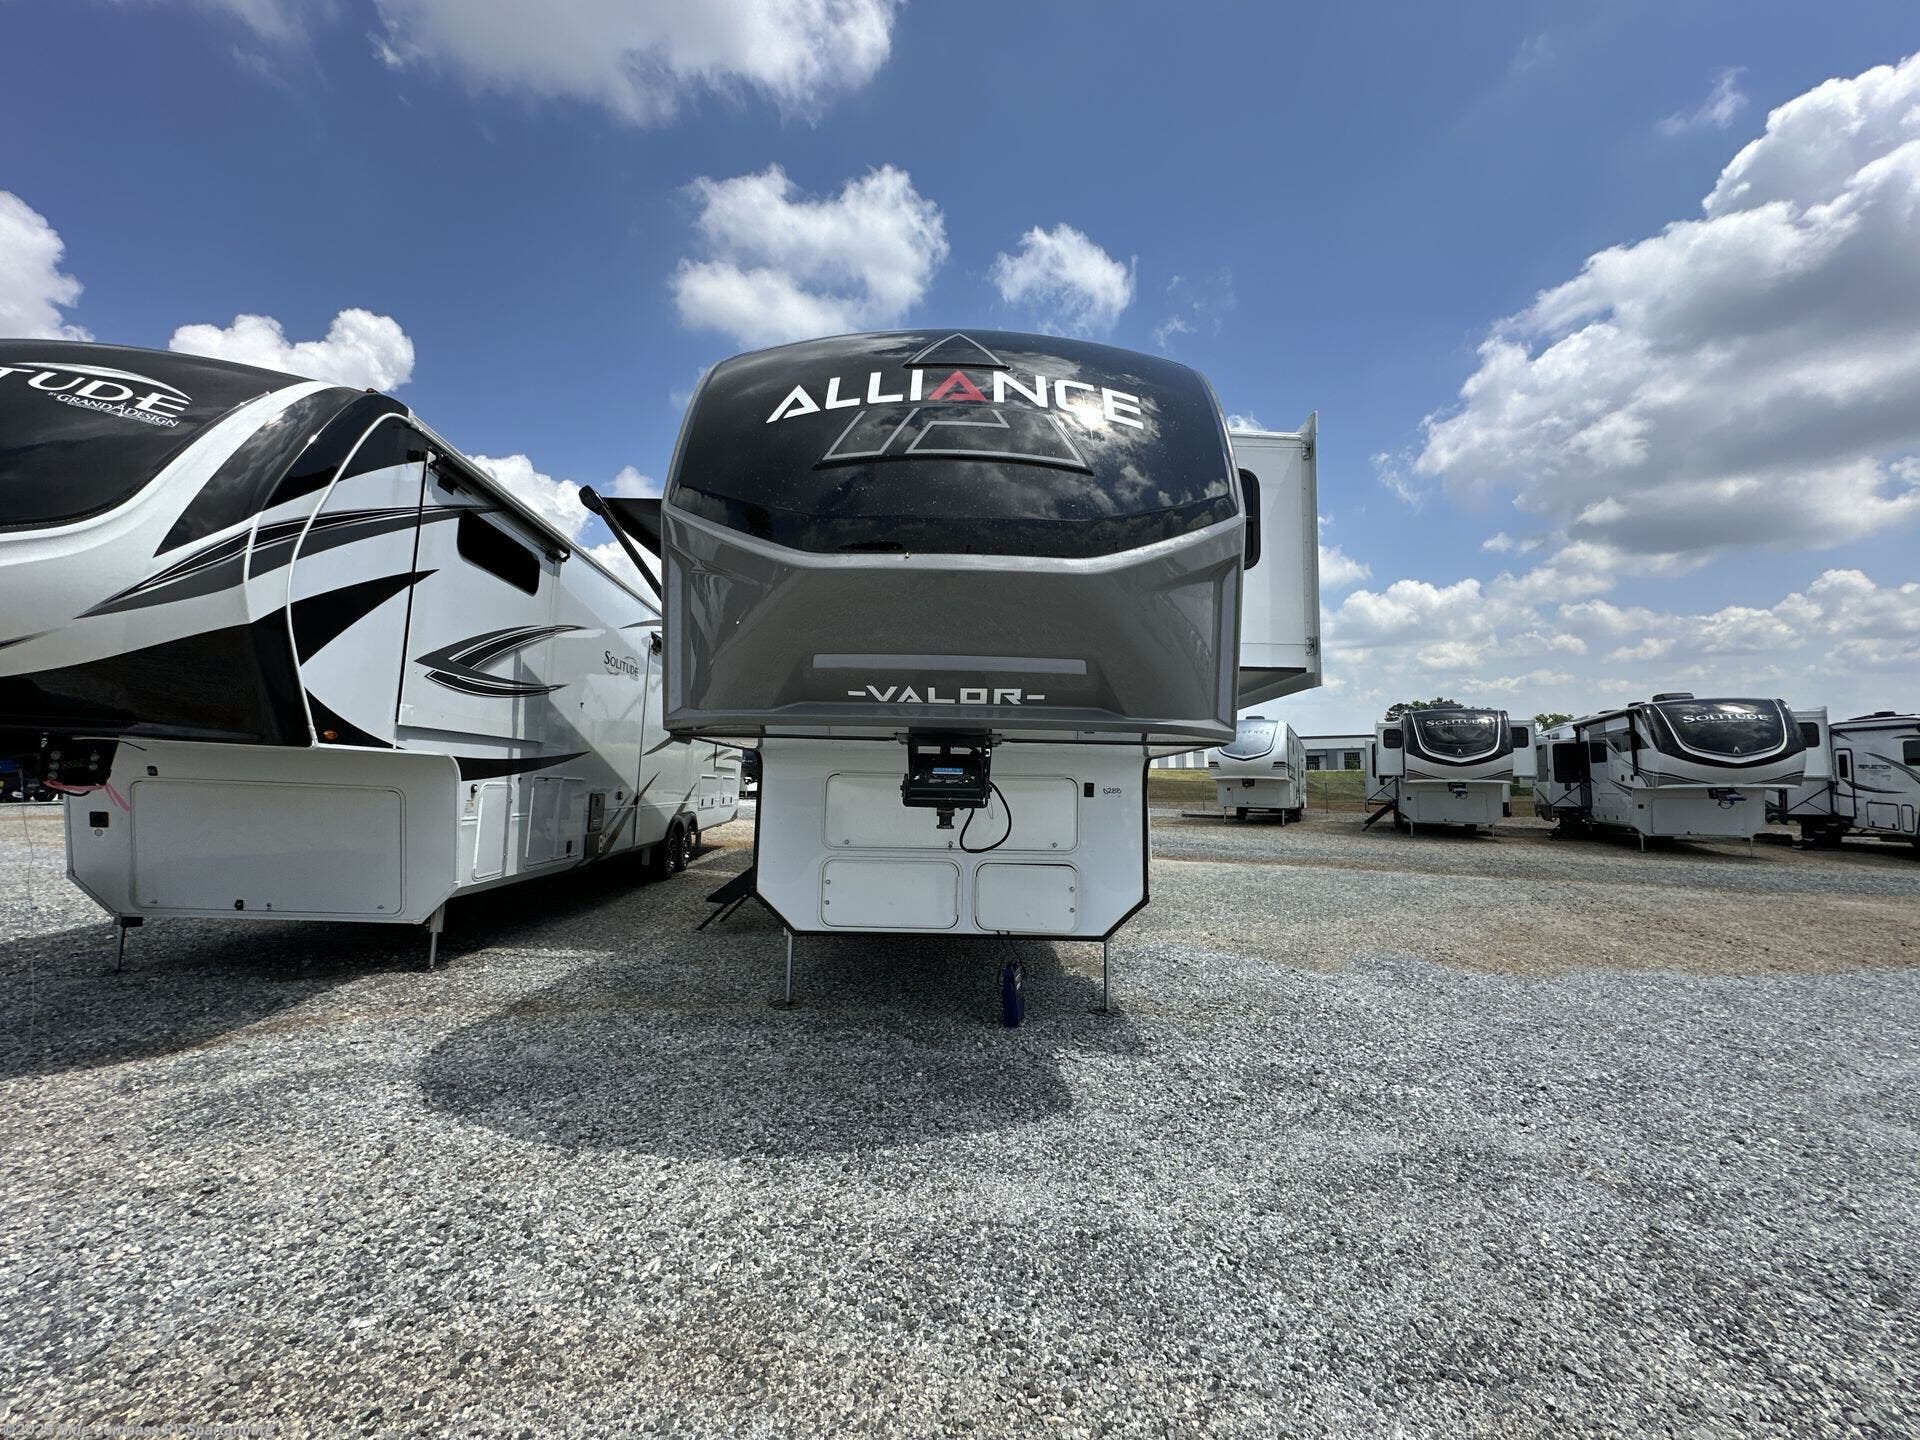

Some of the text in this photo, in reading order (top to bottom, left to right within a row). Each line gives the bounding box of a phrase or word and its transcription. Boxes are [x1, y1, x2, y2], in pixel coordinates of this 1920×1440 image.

[766, 369, 1145, 430] ALLIANCE
[604, 650, 639, 677] SOLITUDE
[1426, 719, 1490, 727] SOLITUD
[1682, 713, 1769, 723] SOLITUDE
